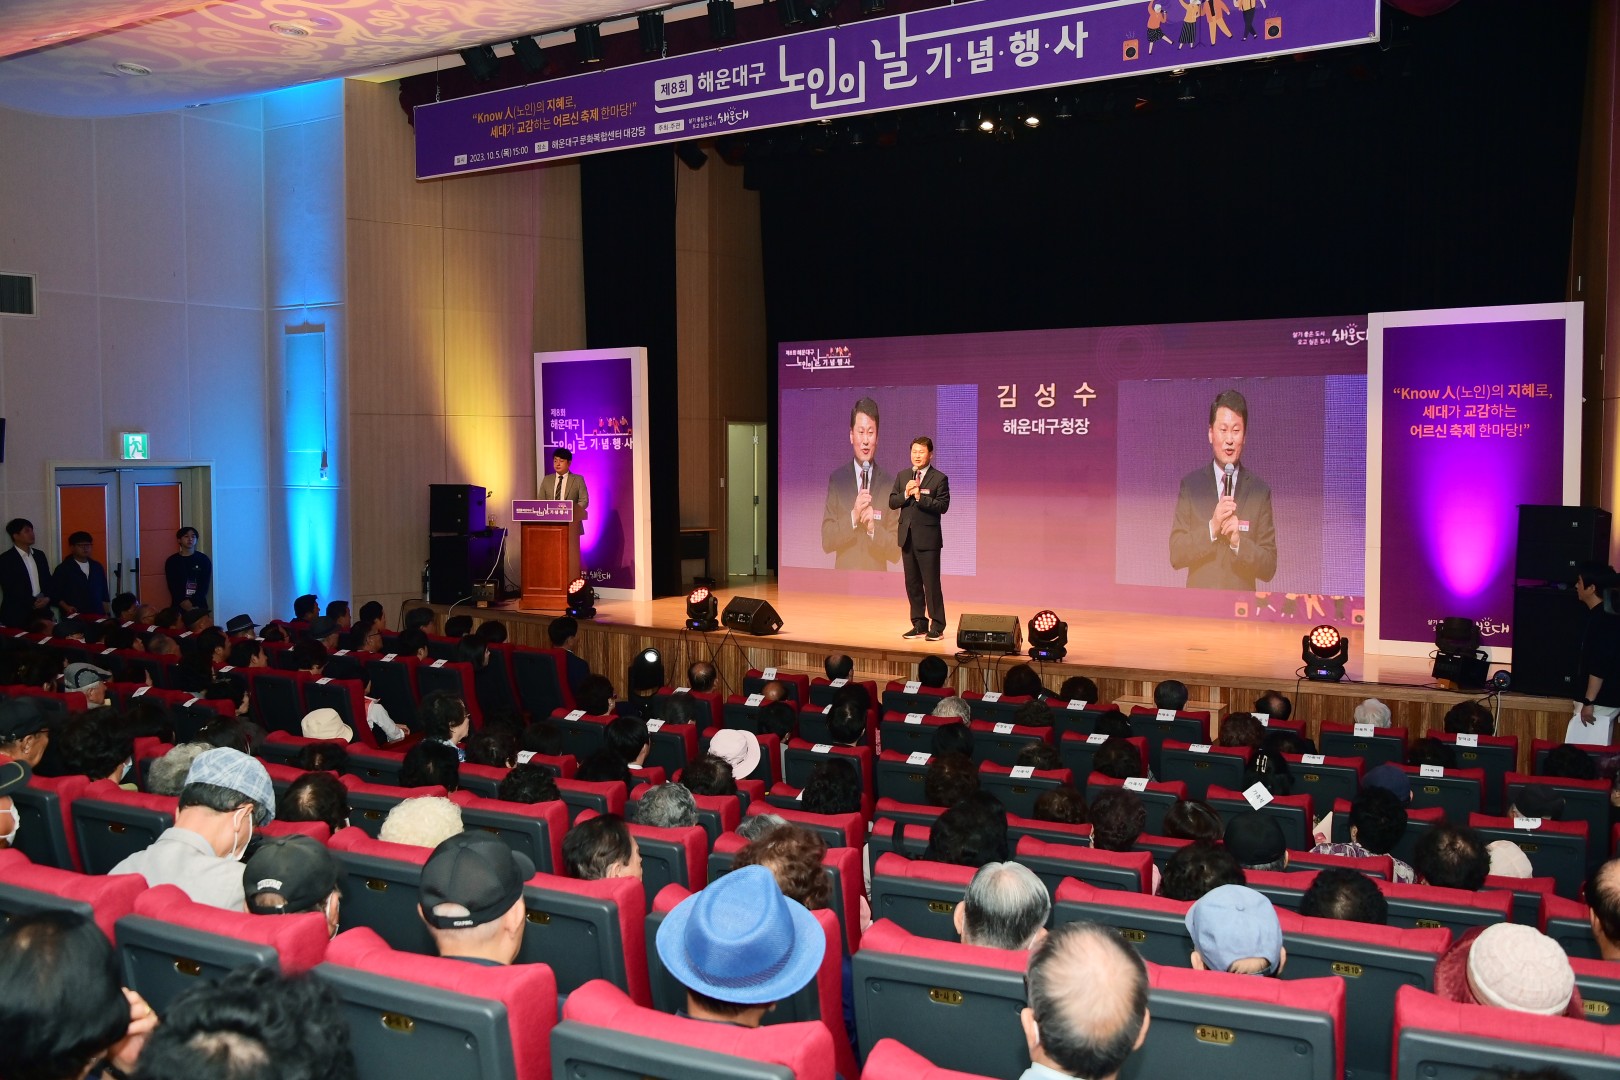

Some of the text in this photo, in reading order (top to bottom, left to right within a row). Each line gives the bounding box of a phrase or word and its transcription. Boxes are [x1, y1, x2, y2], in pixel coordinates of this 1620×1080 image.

[660, 79, 688, 96] 제8회
[697, 62, 766, 93] 해운대구
[870, 13, 918, 91] 날
[472, 110, 503, 124] “Know
[546, 95, 577, 110] 지혜로,
[490, 101, 637, 139] 세대가 교감하는 어르신 축제 한마당!”
[551, 125, 646, 150] 해운대구 문화복합센터 대강당
[512, 146, 529, 156] 15:00
[1393, 382, 1553, 401] “Know 人(노인)의 지혜로,
[1422, 403, 1518, 419] 세대가 교감하는
[551, 419, 580, 430] 해운대구
[1002, 417, 1090, 435] 해운대구청장
[1410, 423, 1531, 439] 어르신 축제 한마당!”
[1199, 1028, 1230, 1042] B-사 10
